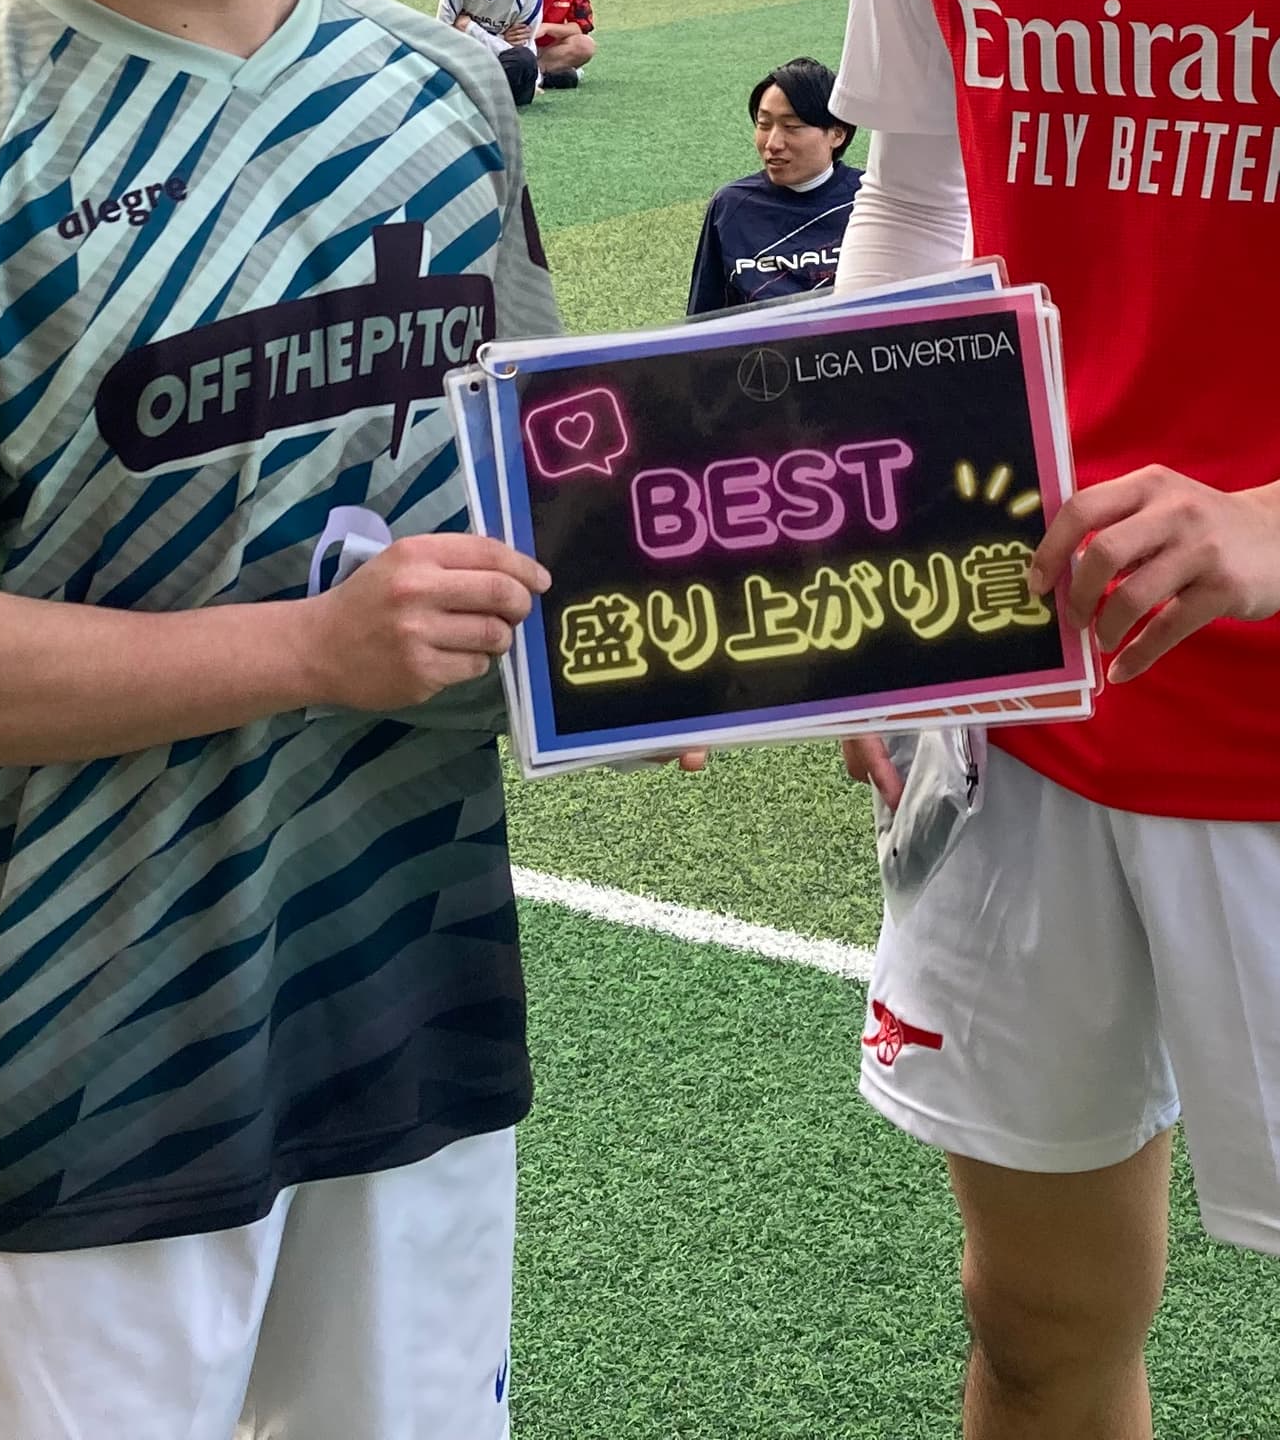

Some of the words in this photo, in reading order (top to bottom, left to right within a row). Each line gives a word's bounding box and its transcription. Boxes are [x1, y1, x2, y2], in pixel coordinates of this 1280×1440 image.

[1006, 111, 1088, 187] FLY
[57, 177, 188, 240] alegre
[136, 348, 254, 438] OFF
[630, 437, 914, 560] BEST
[560, 541, 1051, 686] 盛り上がり賞
